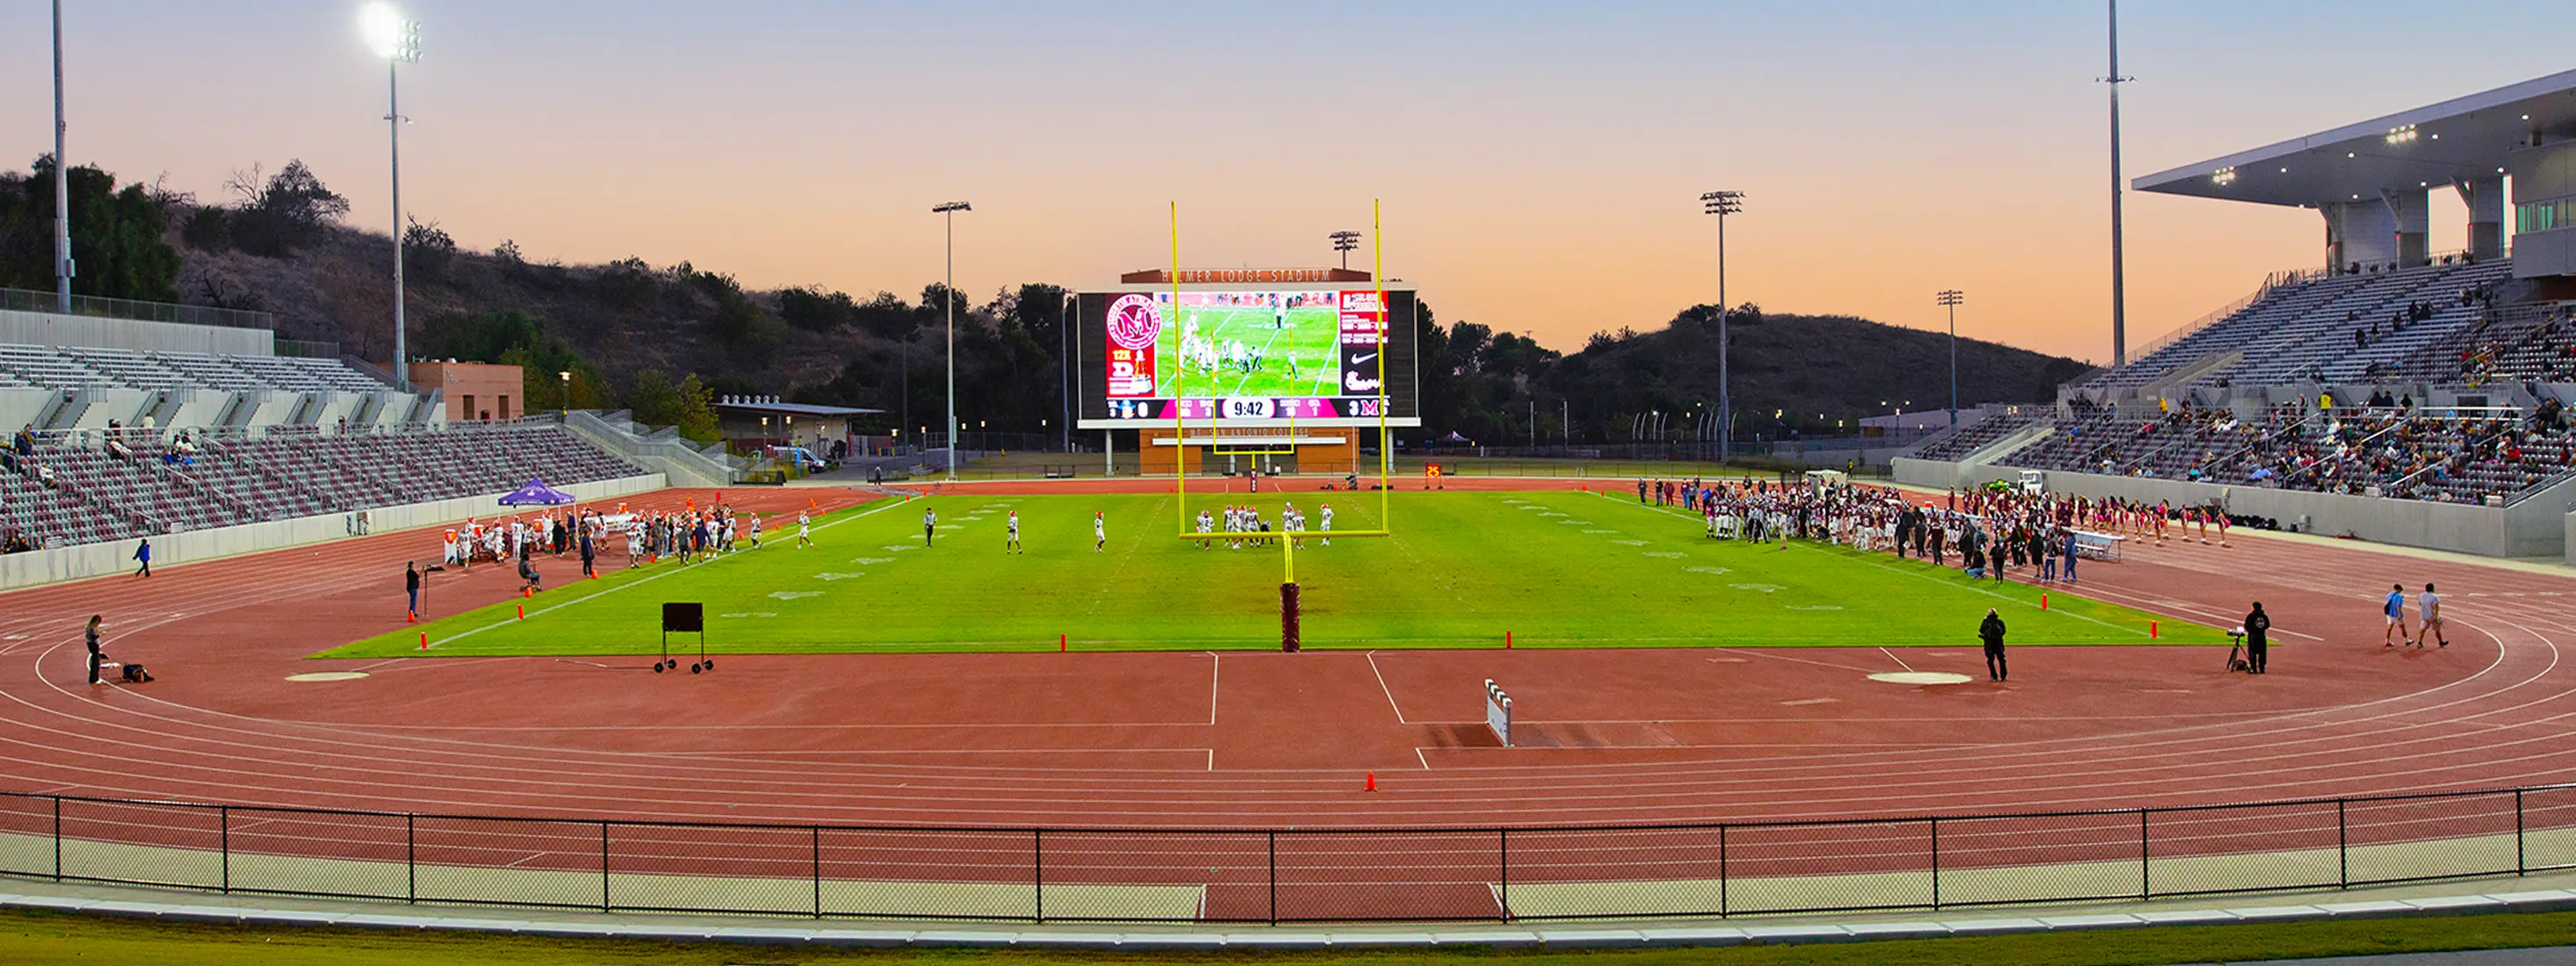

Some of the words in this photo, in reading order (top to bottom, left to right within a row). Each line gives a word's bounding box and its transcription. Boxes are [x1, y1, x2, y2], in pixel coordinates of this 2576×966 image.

[1162, 270, 1212, 282] HLMER
[1220, 270, 1261, 282] LODGE
[1271, 270, 1331, 282] STADIUM
[1118, 307, 1151, 337] M
[1112, 349, 1132, 361] 12X
[1234, 400, 1263, 416] 9:42
[1349, 400, 1359, 415] 3
[1360, 400, 1379, 415] M
[1230, 428, 1267, 436] ANTONIO
[1274, 428, 1308, 436] COLEGE
[1427, 466, 1439, 477] 25
